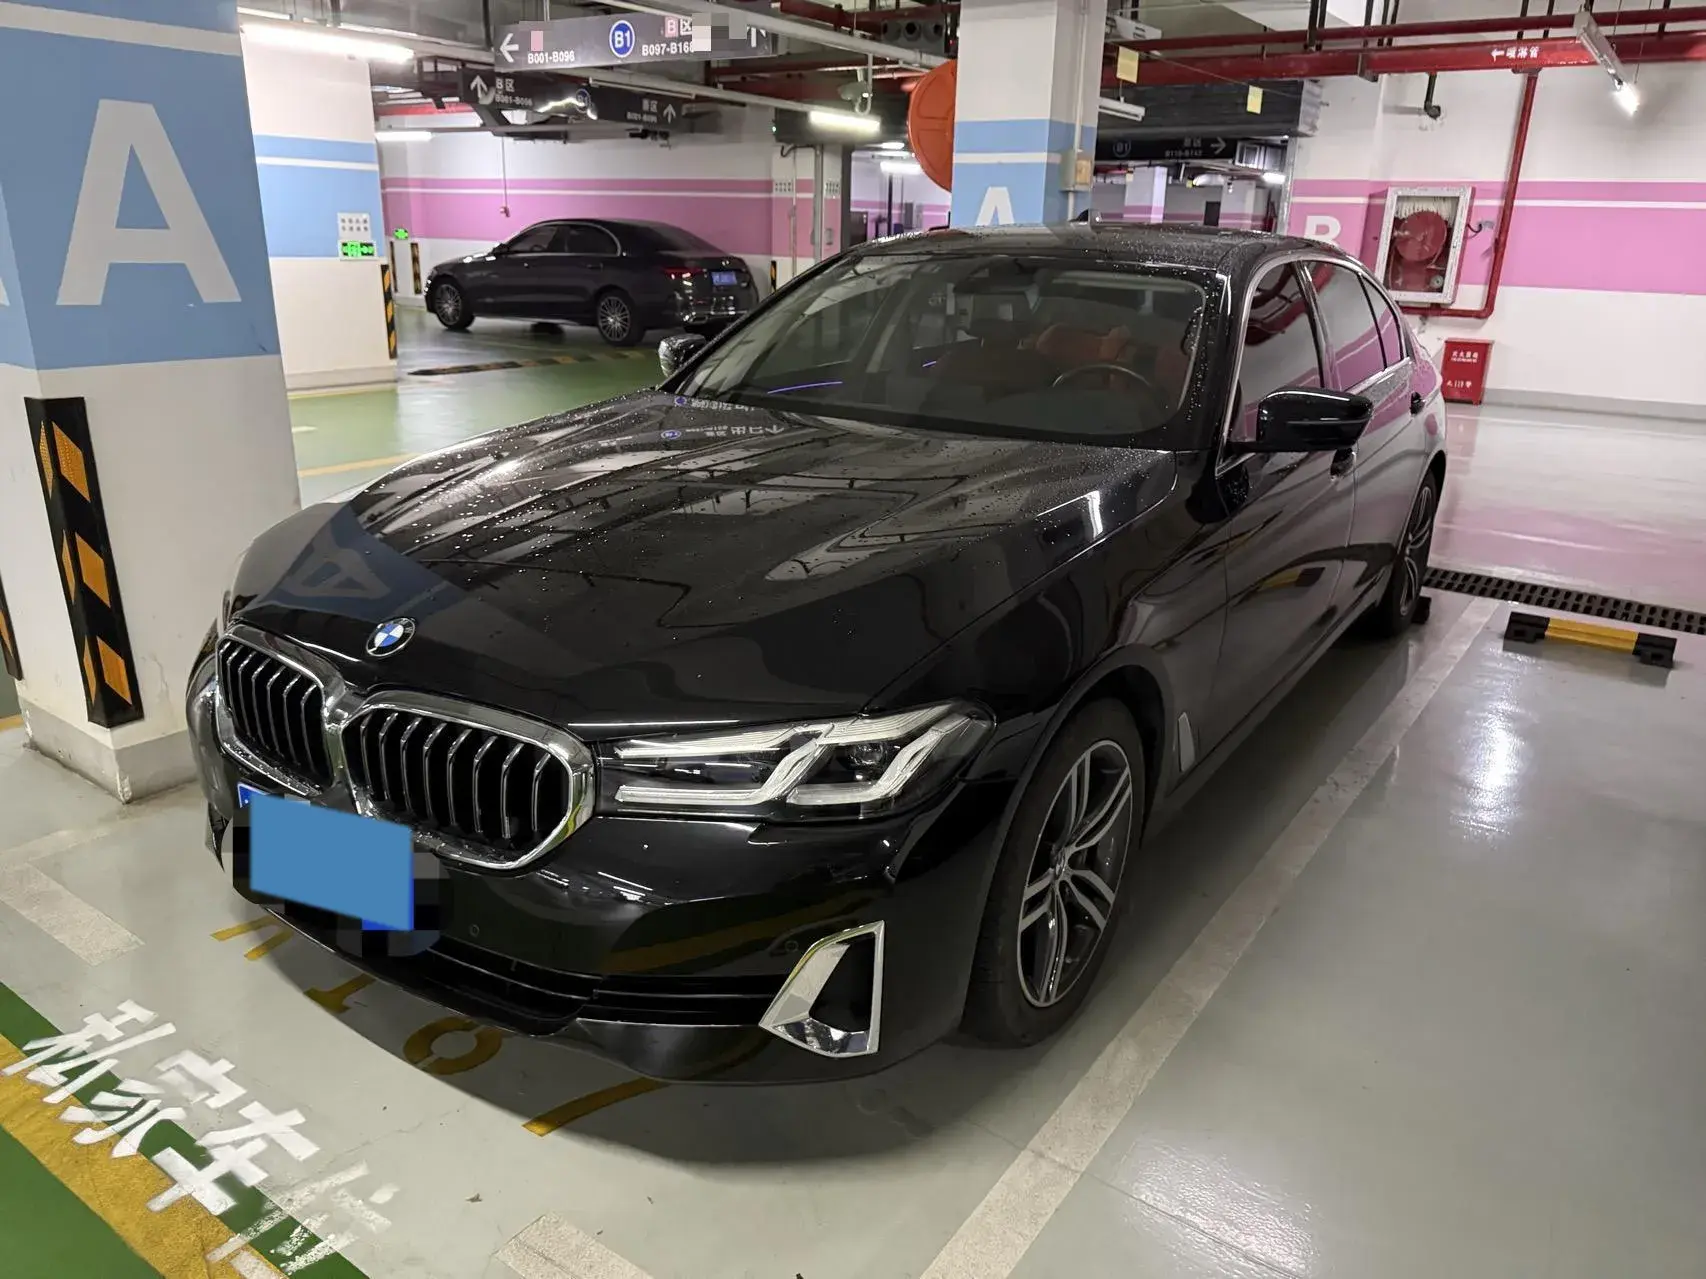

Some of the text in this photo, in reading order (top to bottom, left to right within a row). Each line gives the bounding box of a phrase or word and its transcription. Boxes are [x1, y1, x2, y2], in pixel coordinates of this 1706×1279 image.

[614, 33, 631, 48] B1
[527, 51, 575, 64] B001-B096
[56, 99, 241, 305] A
[975, 187, 1016, 226] A
